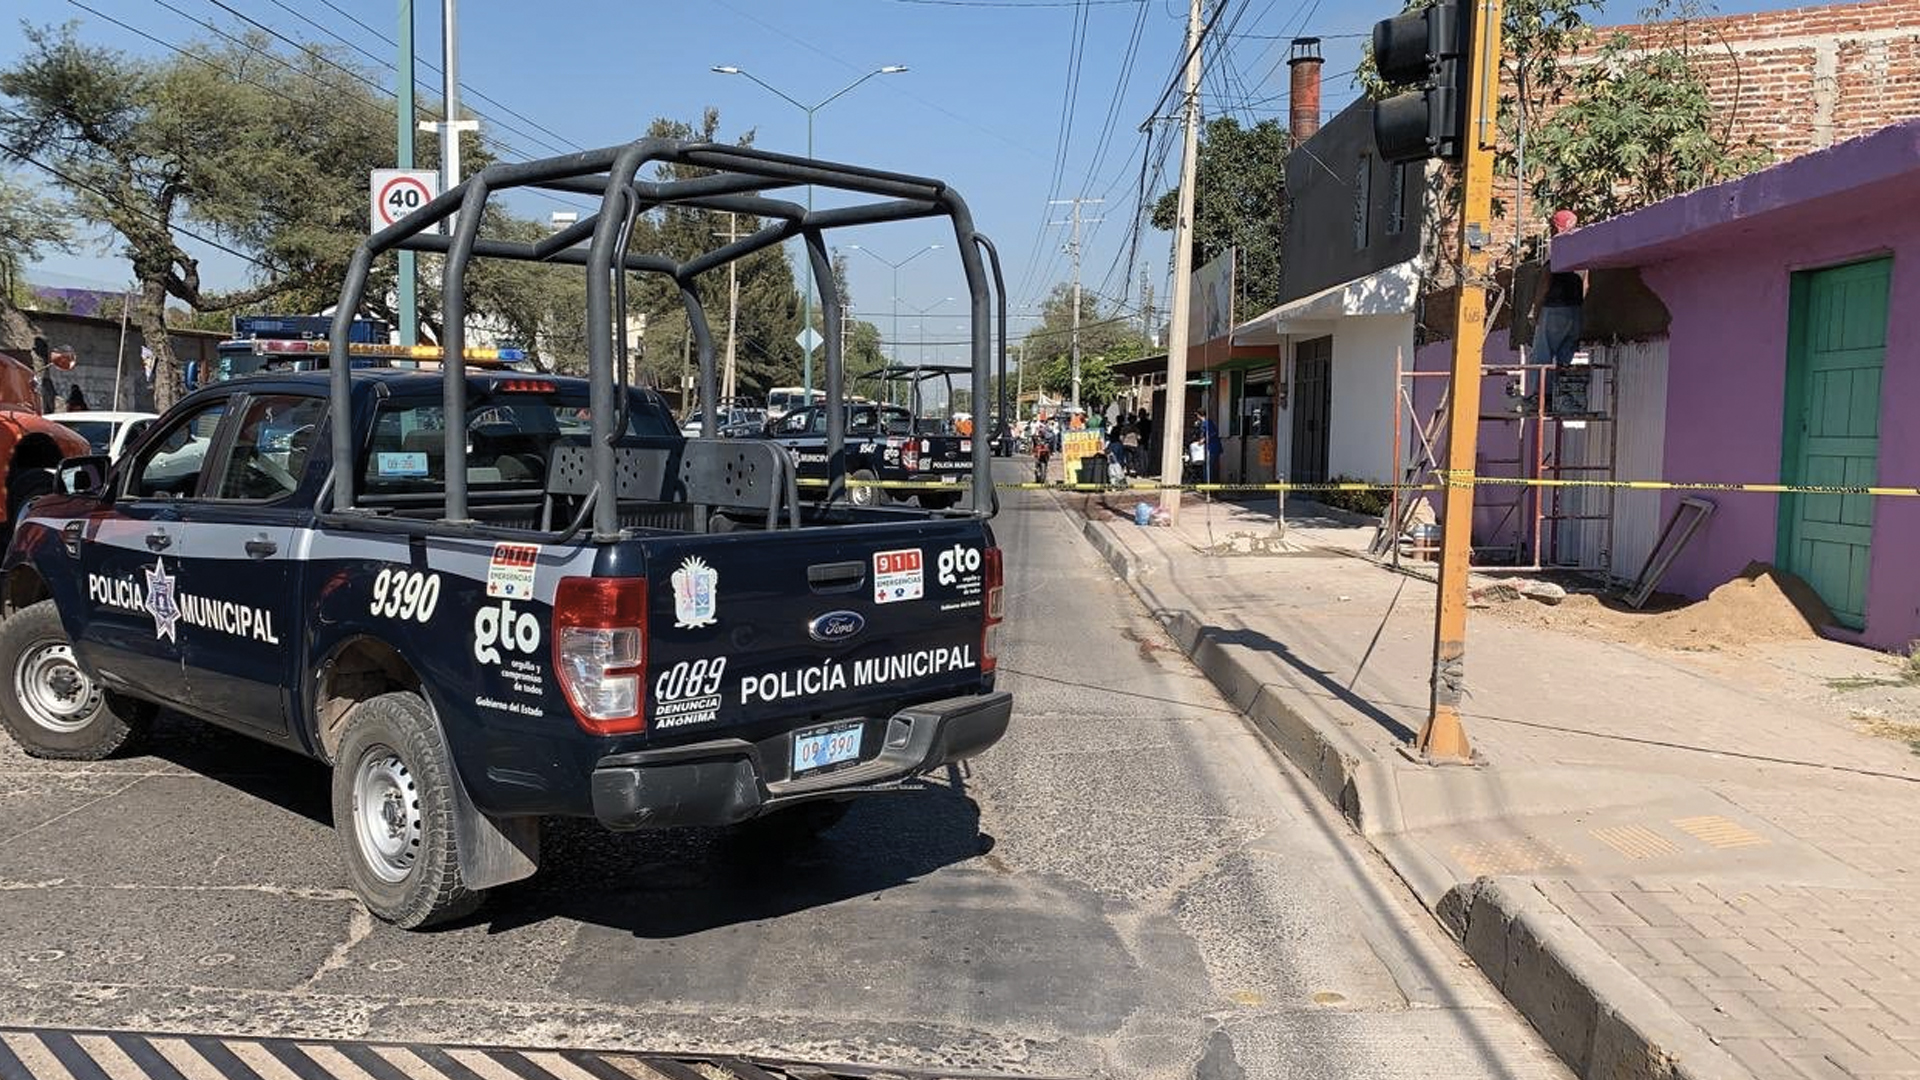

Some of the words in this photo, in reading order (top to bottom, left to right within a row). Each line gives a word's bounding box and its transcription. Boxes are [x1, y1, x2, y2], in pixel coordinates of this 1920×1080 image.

[389, 189, 419, 208] 40
[495, 545, 537, 565] 911
[880, 554, 917, 571] 911
[938, 544, 980, 586] gto
[490, 572, 533, 583] EMERGENCIAS
[877, 577, 921, 587] EMERGENCIAS
[370, 568, 441, 623] 9390
[89, 573, 146, 612] POLICÍA
[180, 592, 279, 645] MUNICIPAL
[474, 600, 541, 664] gto
[825, 617, 853, 634] Ford
[511, 660, 535, 671] orgullo
[741, 658, 847, 704] POLICÍA
[854, 644, 976, 686] MUNICIPAL
[501, 670, 542, 683] compromiso
[513, 682, 522, 691] de
[523, 684, 543, 695] todos
[475, 696, 508, 710] Gobierno
[509, 702, 520, 712] del
[521, 704, 543, 717] Estado
[656, 698, 718, 716] DENUNCIA
